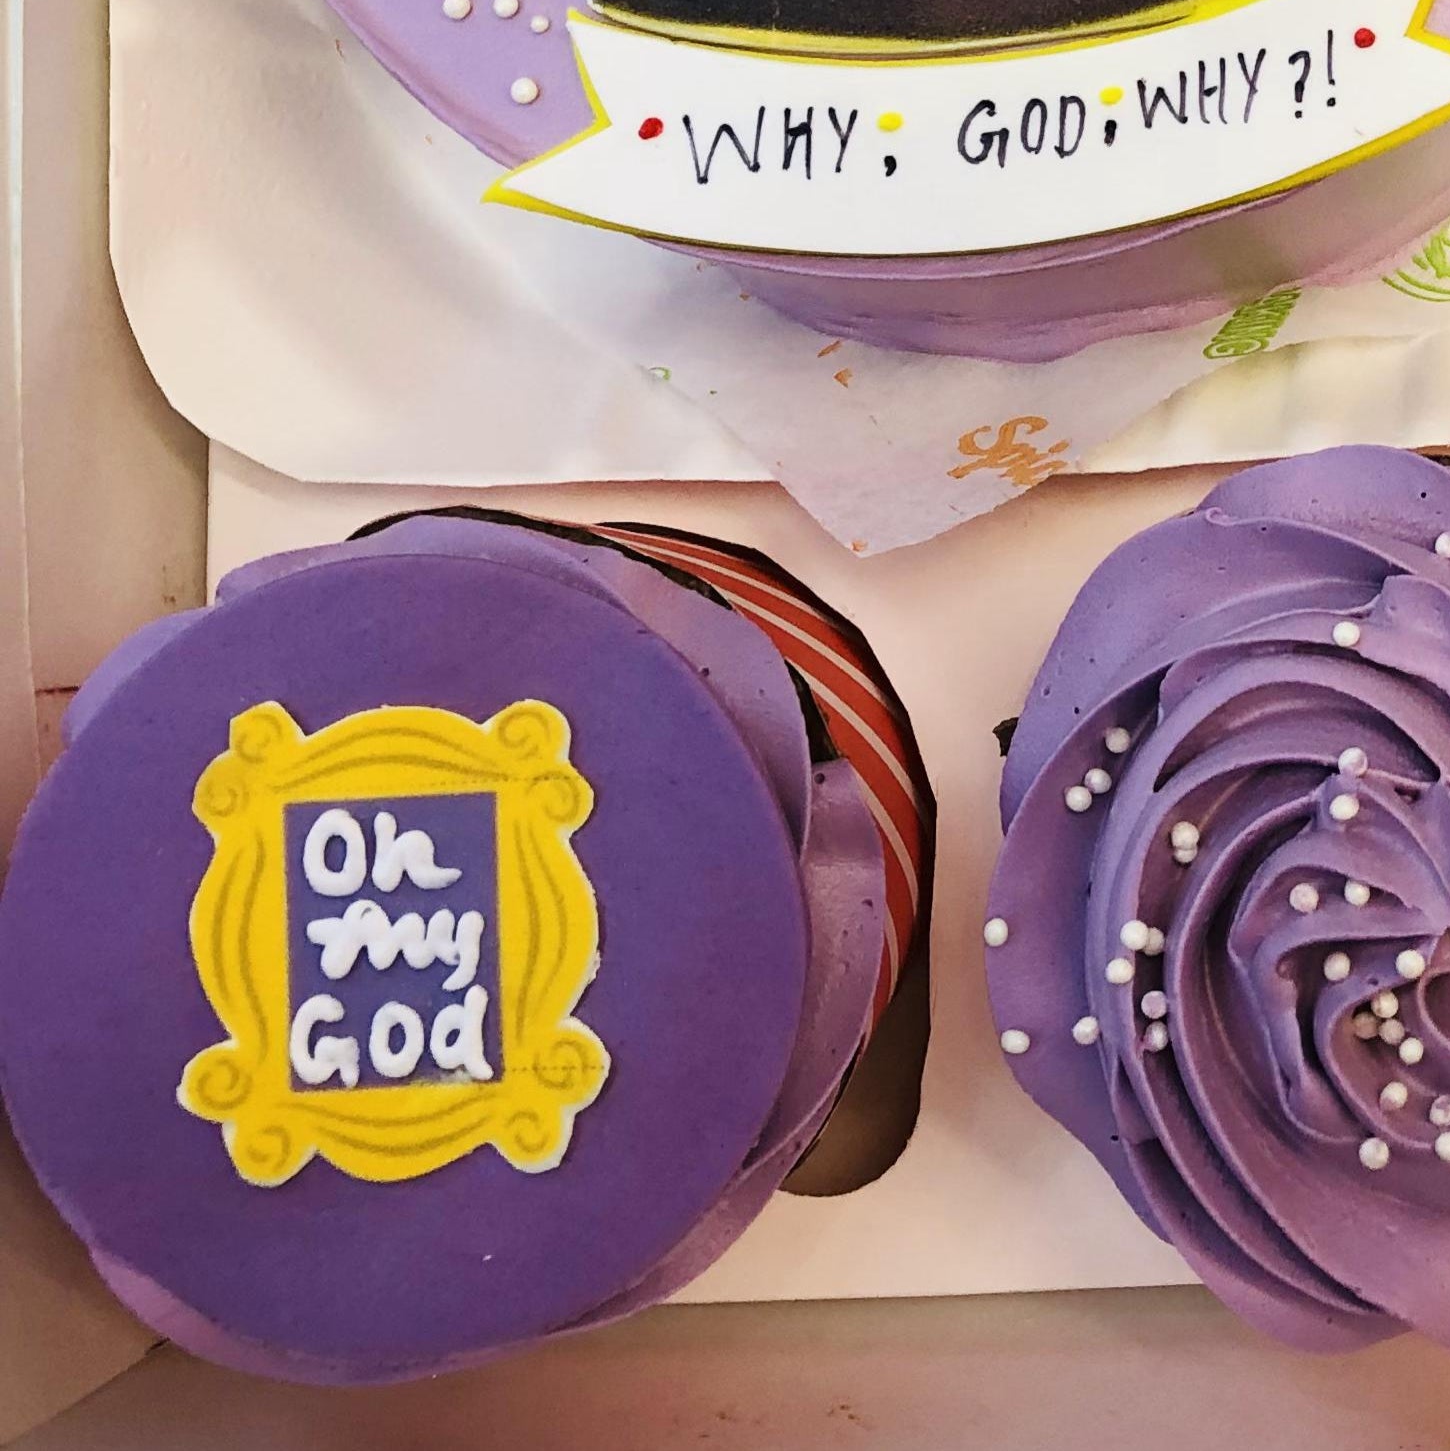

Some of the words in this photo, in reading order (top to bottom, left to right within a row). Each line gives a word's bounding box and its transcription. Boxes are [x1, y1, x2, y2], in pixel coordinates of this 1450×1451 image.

[303, 808, 462, 896] Oh
[307, 899, 484, 991] my
[290, 985, 494, 1088] God
